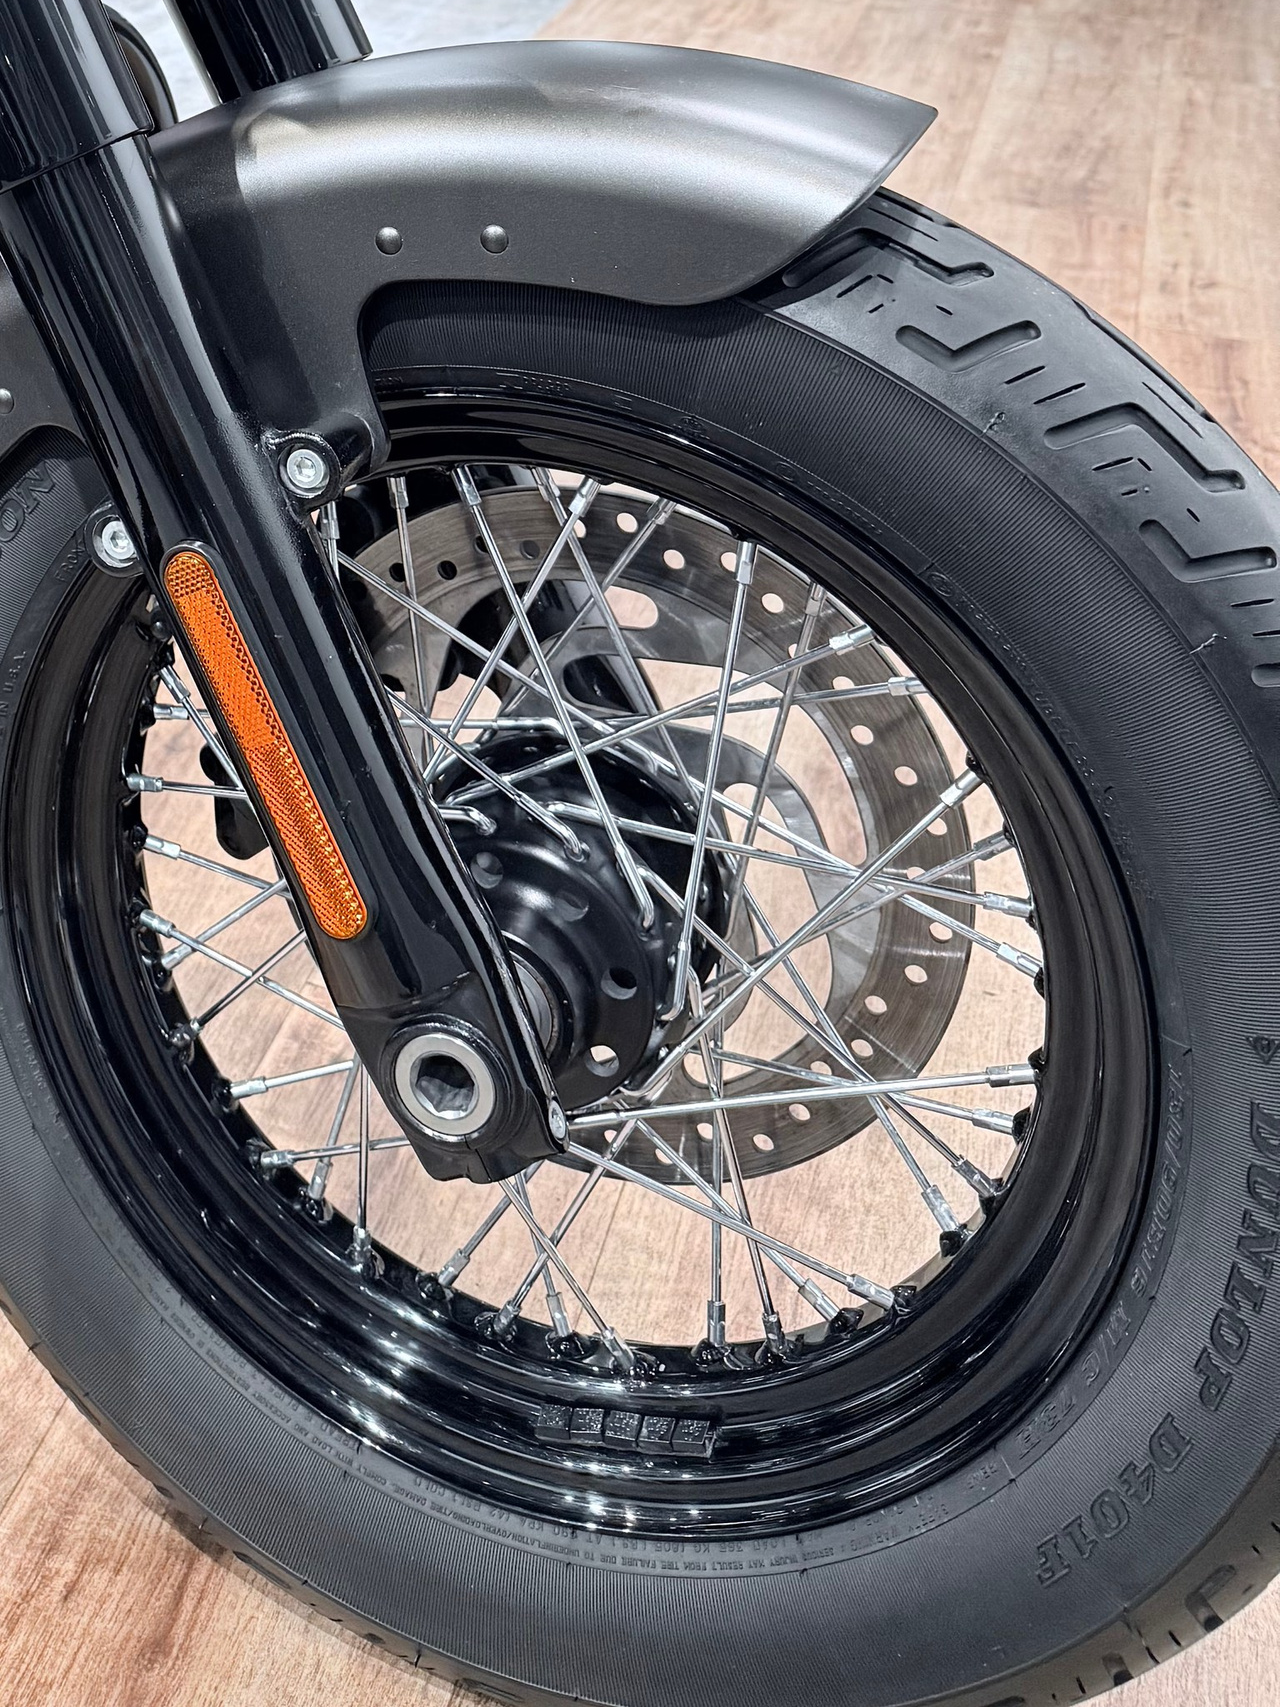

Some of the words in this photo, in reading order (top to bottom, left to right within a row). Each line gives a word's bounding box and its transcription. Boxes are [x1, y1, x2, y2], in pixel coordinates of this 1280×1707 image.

[1, 646, 27, 695] U.S.A.
[1195, 1098, 1280, 1411] DUNLOP
[1037, 1411, 1193, 1588] D401F
